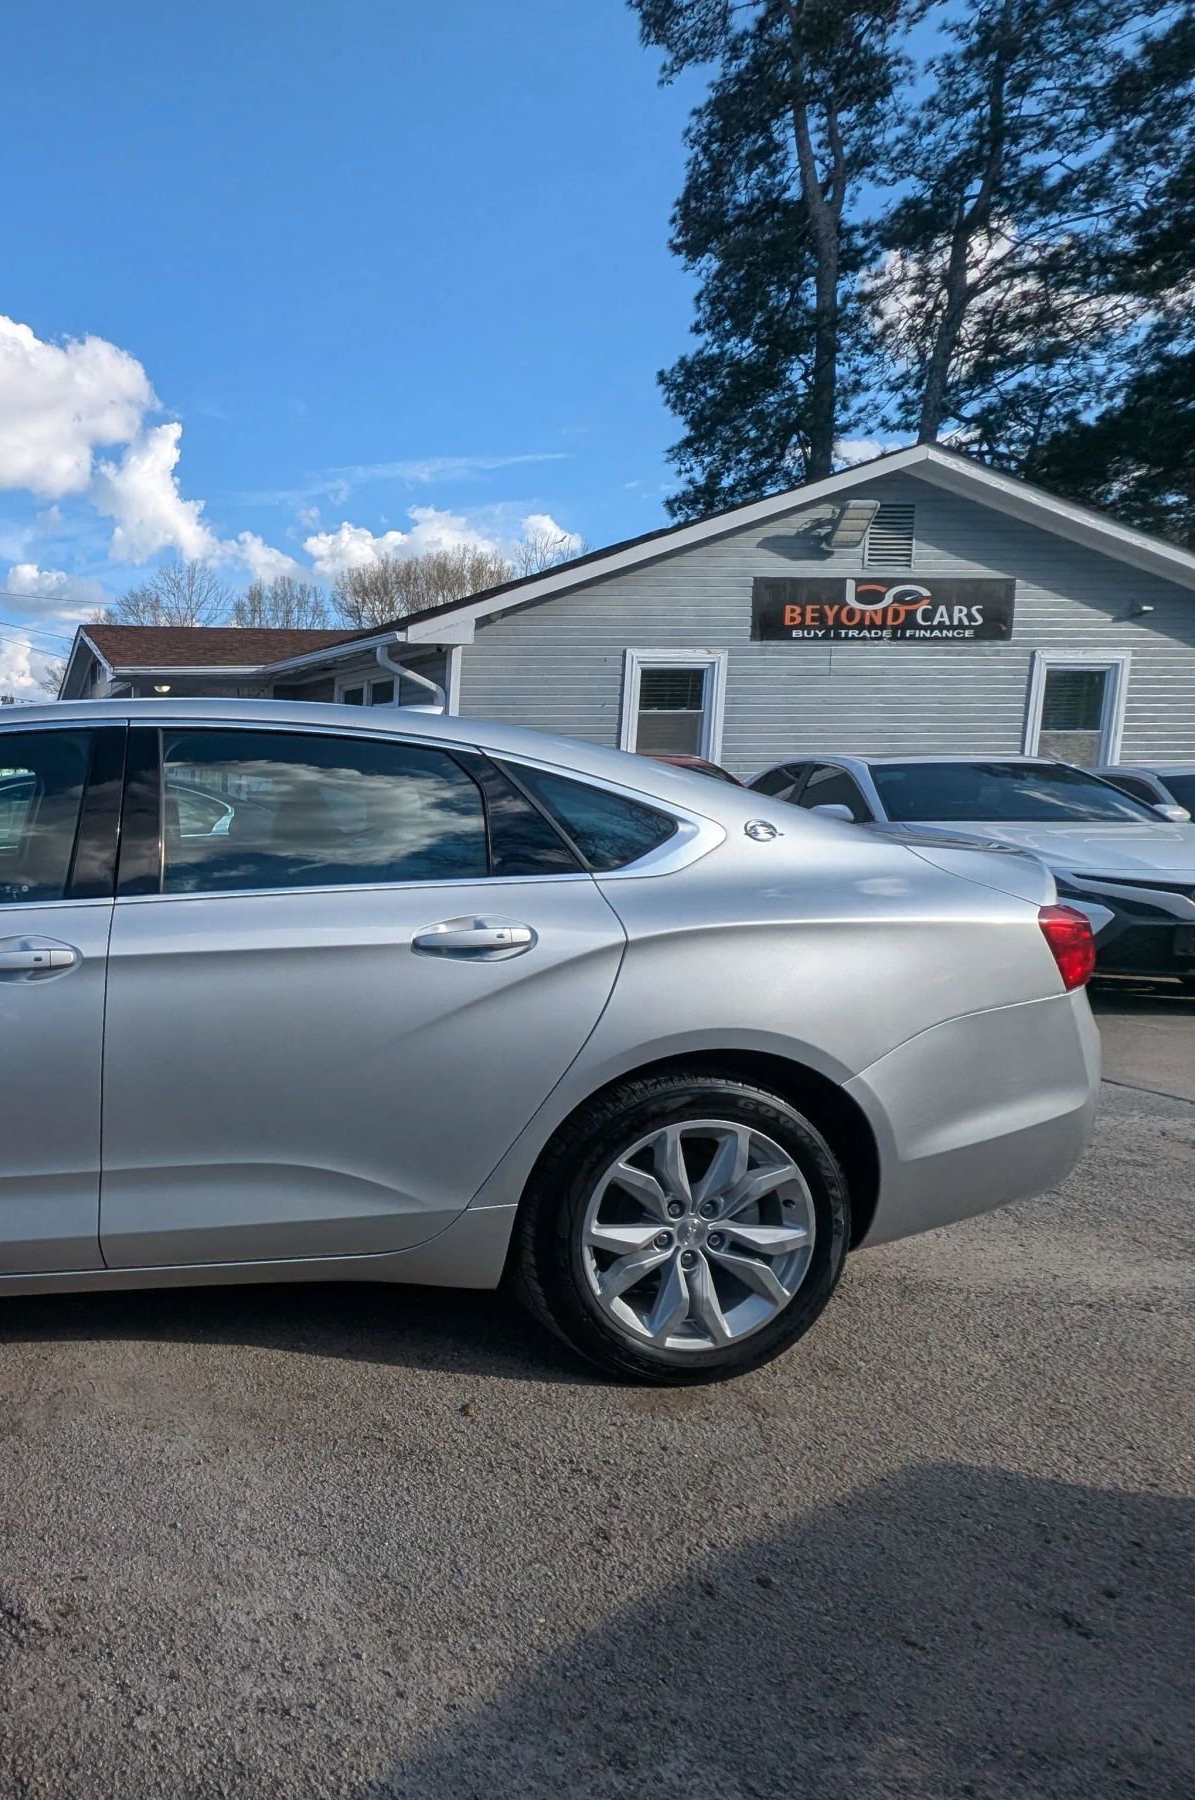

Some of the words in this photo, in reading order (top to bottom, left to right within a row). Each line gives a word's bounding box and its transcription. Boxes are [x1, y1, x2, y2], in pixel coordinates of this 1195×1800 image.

[784, 605, 905, 626] BEYOND
[916, 605, 984, 625] CARS
[792, 629, 825, 638] BUY
[838, 629, 893, 638] TRADE
[906, 629, 975, 638] FINANCE
